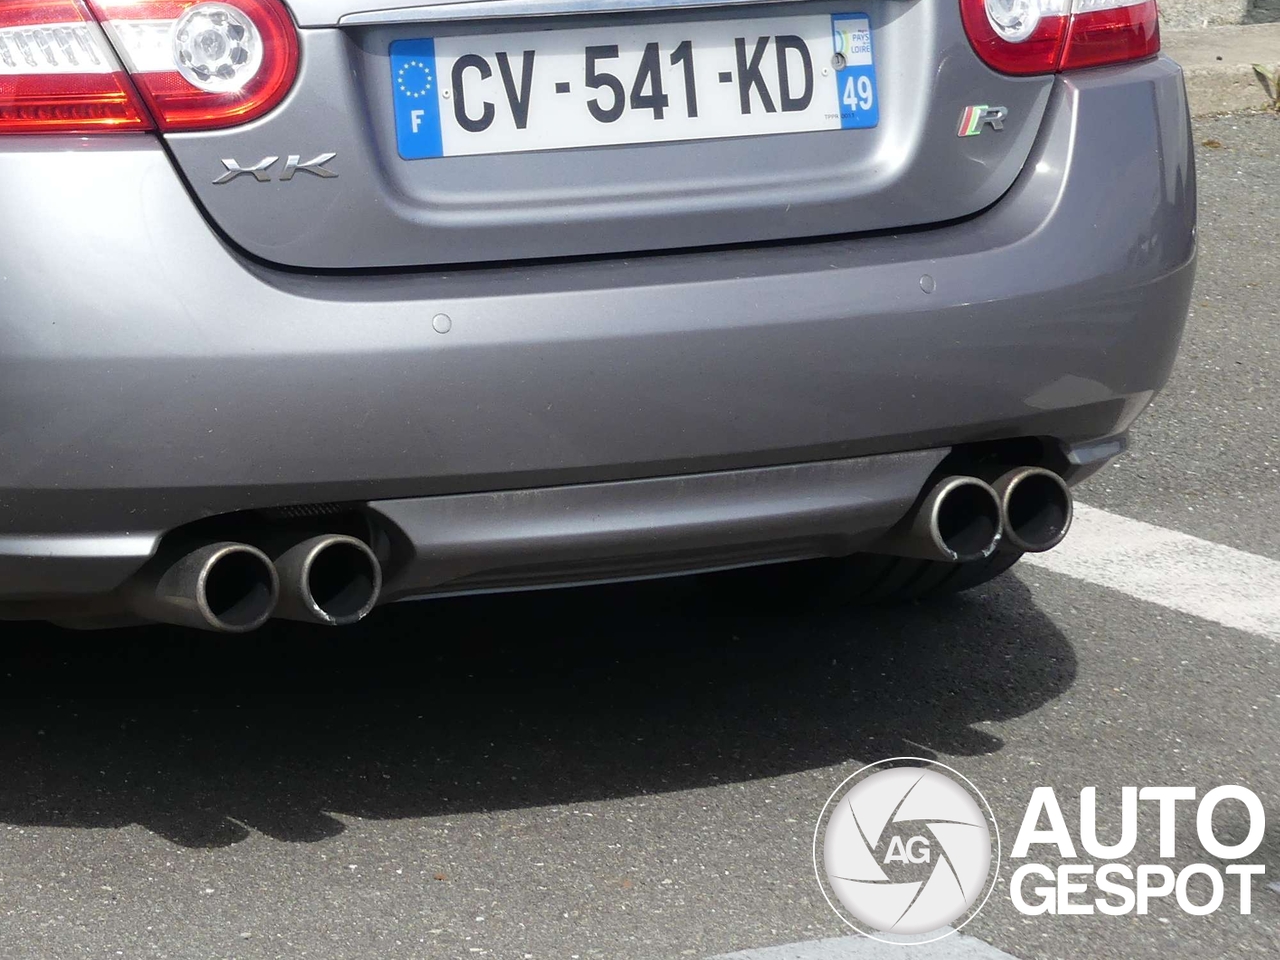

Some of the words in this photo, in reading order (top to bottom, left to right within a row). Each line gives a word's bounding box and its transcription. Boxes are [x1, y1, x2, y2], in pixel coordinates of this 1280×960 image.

[852, 33, 869, 42] PAYS
[851, 45, 870, 54] LOIRE
[843, 76, 873, 111] 49
[411, 110, 424, 132] F
[212, 152, 338, 184] XK
